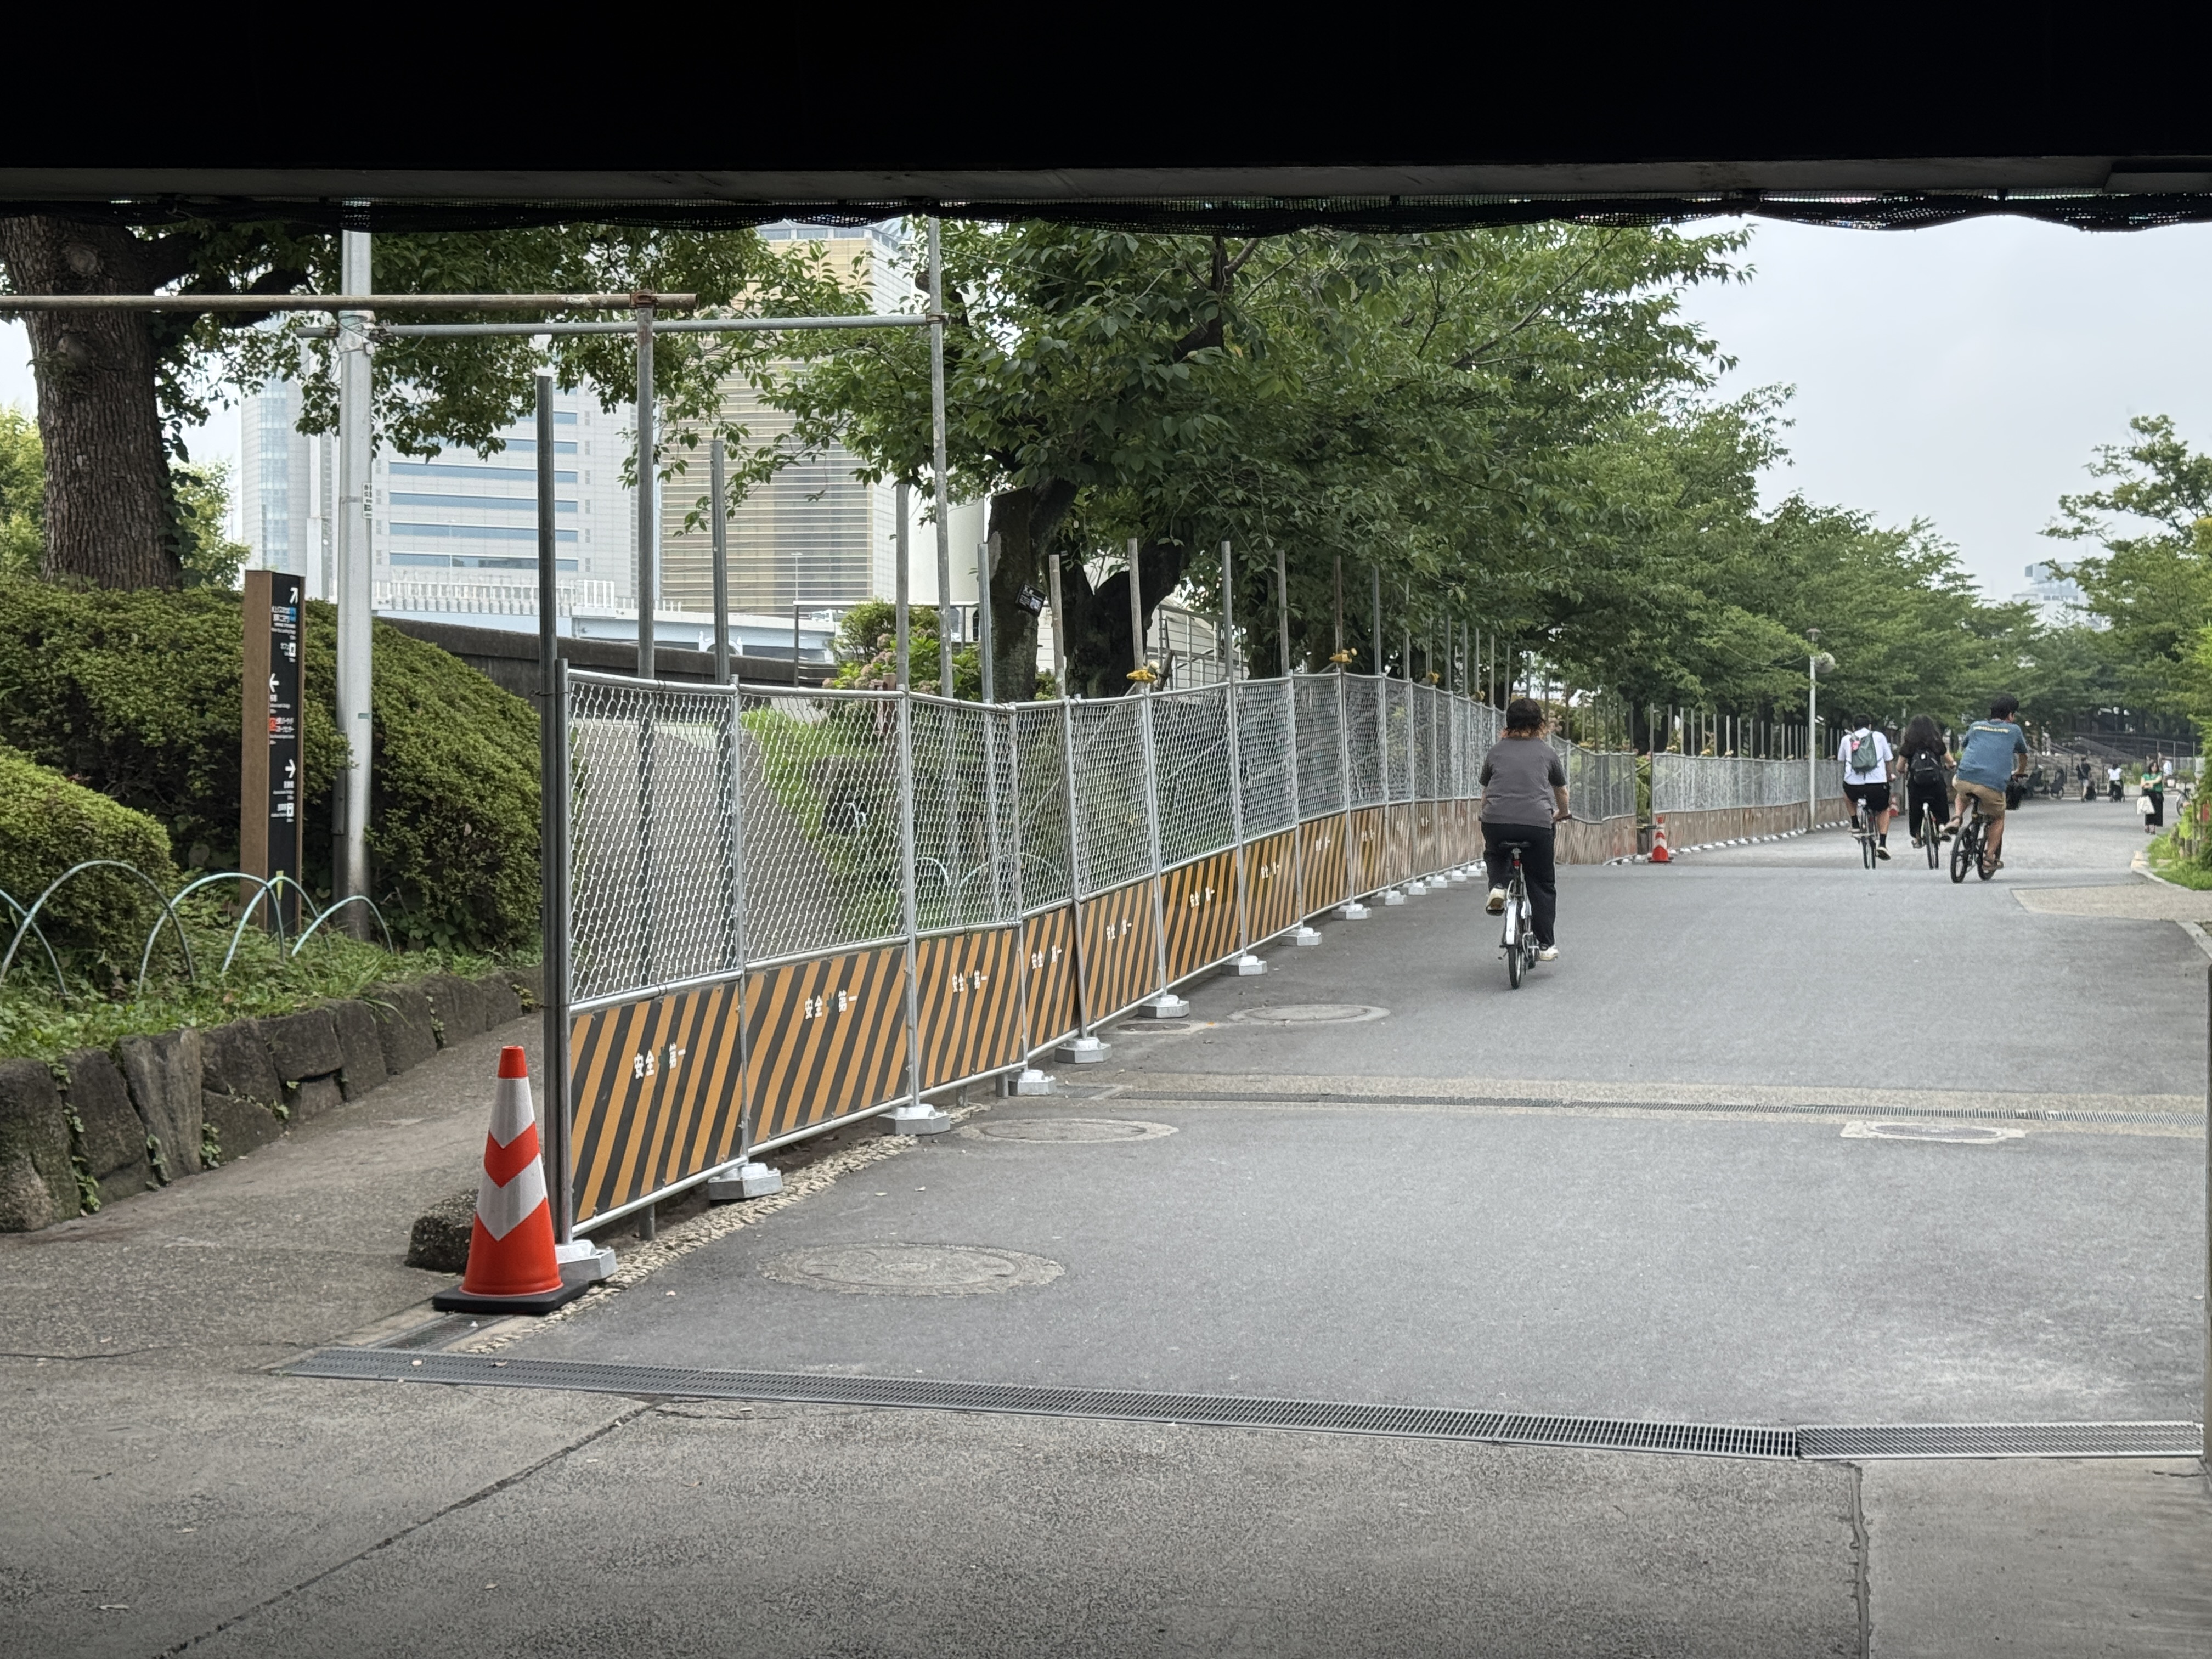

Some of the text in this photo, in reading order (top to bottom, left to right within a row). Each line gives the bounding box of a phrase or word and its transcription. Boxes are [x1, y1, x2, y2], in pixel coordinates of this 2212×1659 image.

[805, 990, 857, 1020] 安全 第一
[634, 1042, 686, 1079] 安全 第一
